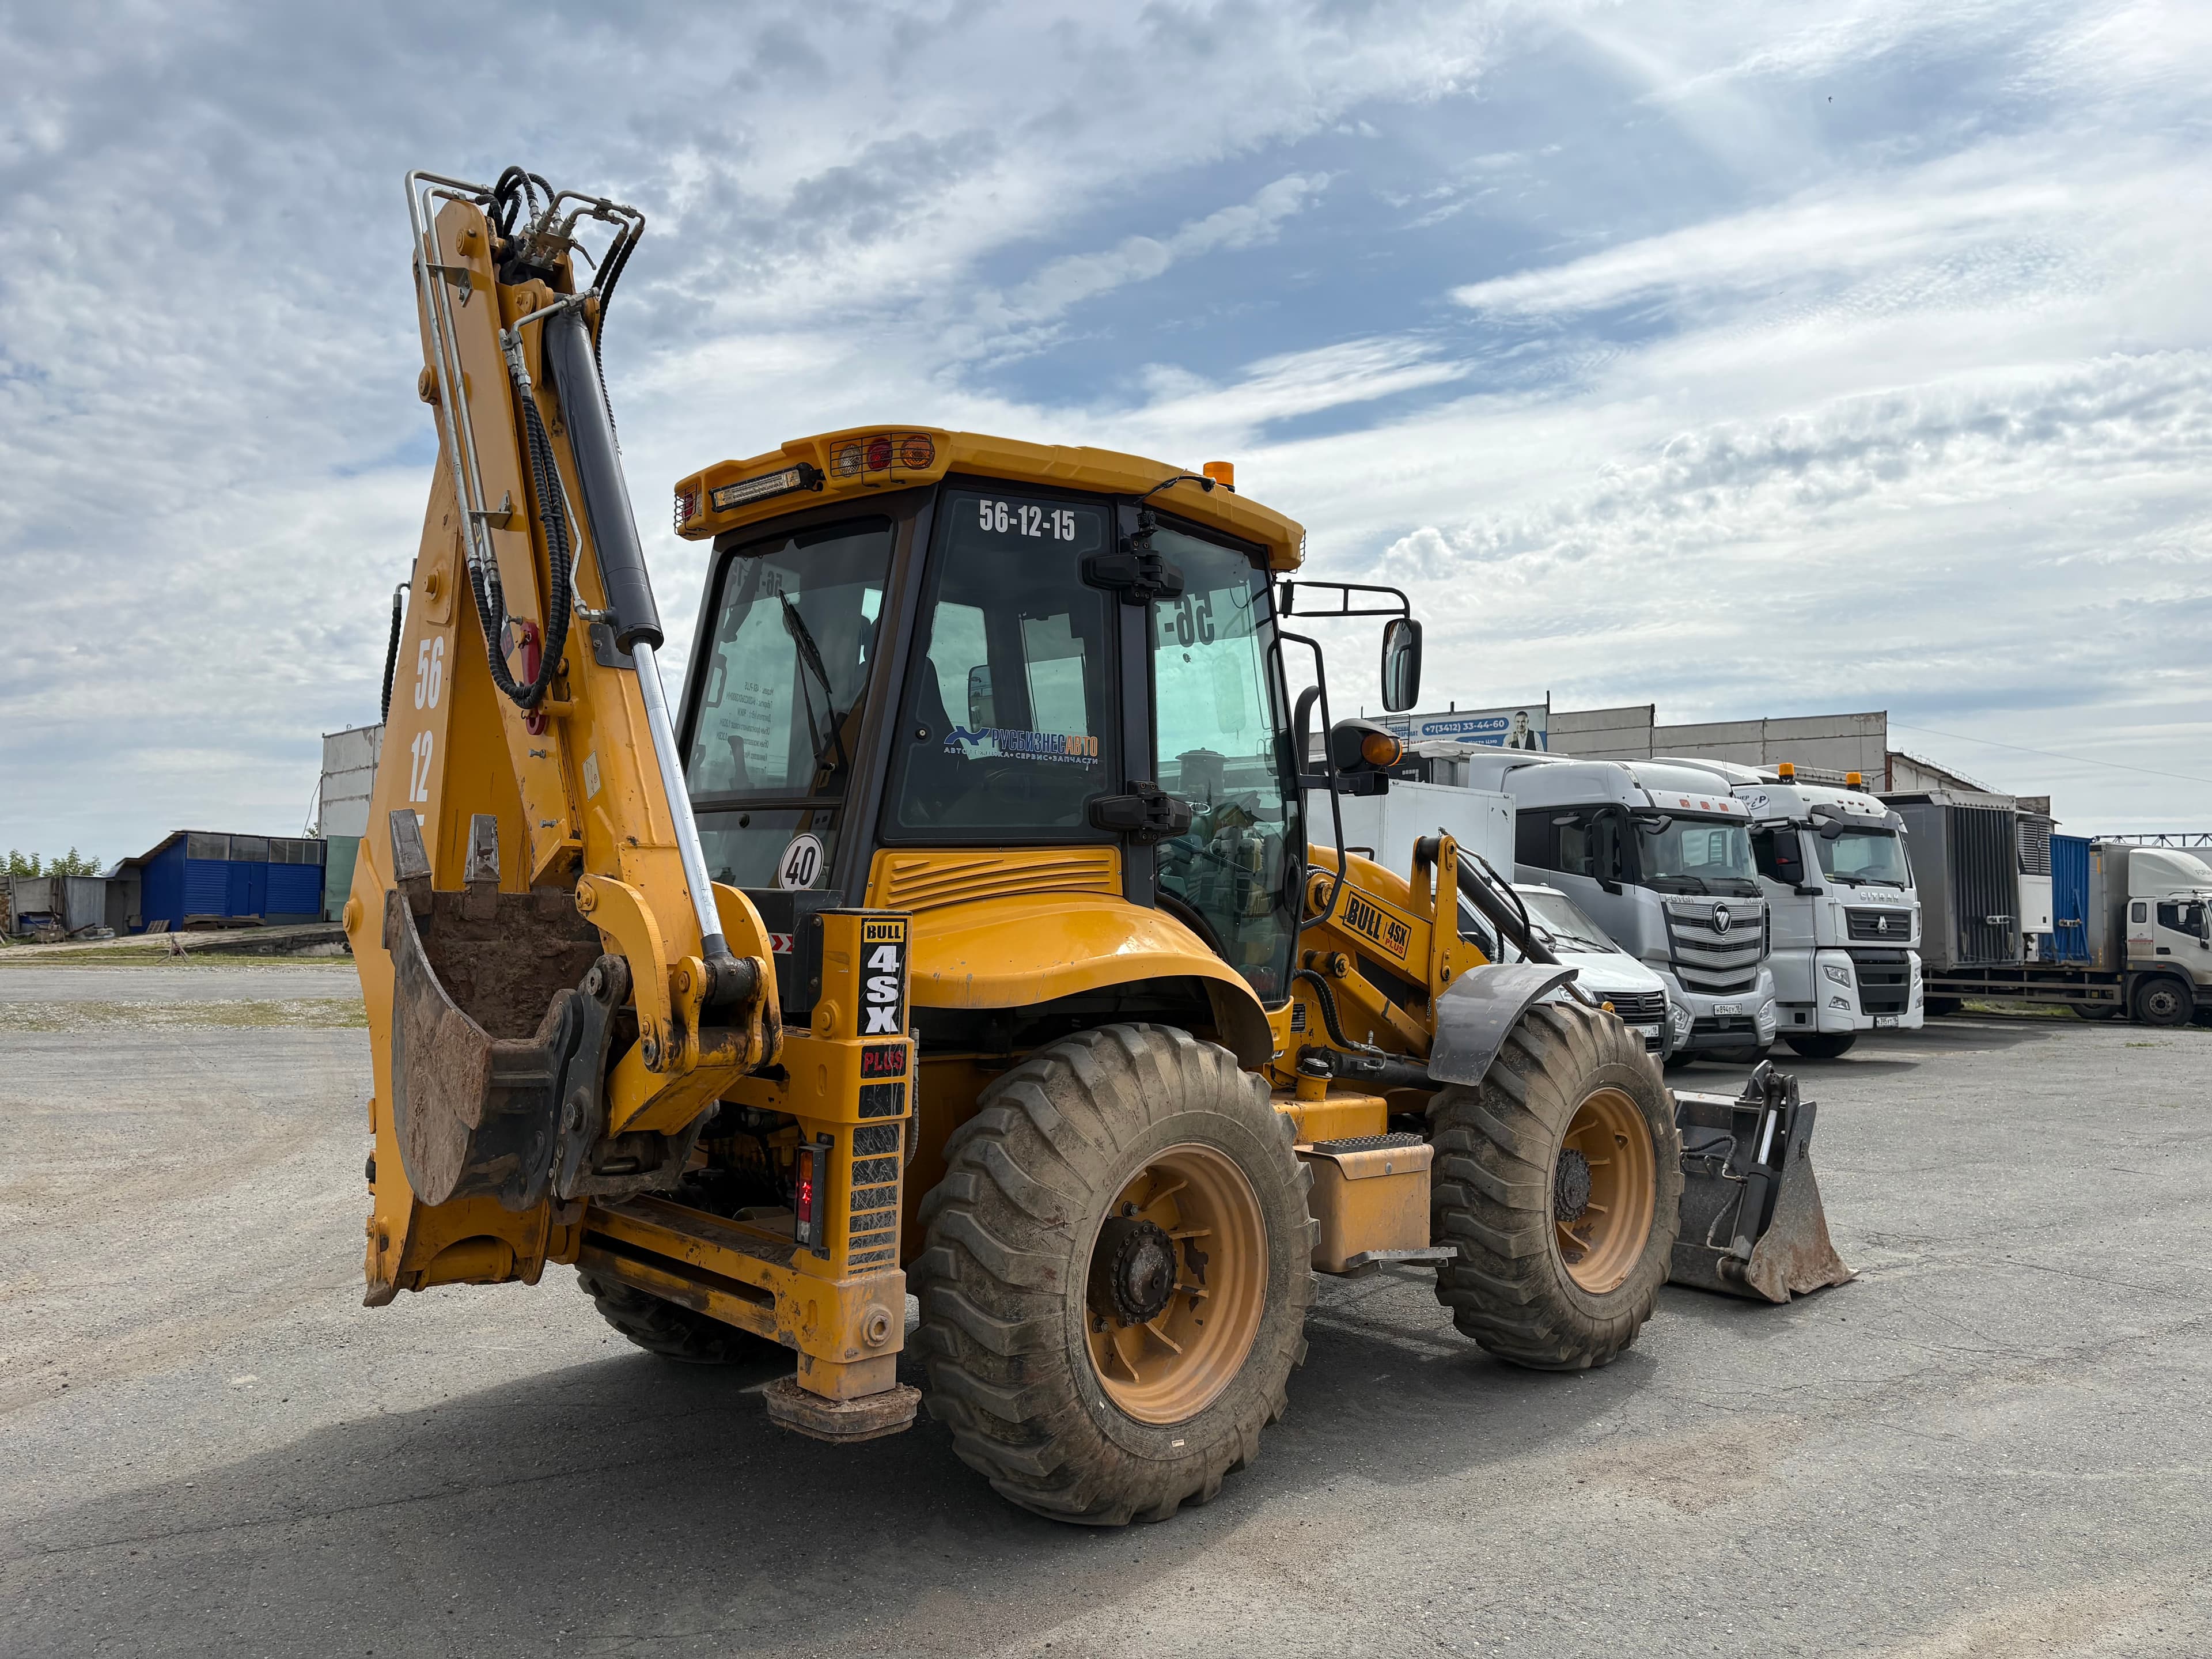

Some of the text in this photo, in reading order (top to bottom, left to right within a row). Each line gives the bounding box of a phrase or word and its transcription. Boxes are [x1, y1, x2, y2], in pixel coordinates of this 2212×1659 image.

[979, 499, 1075, 541] 56-12-15
[414, 636, 444, 710] 56
[1425, 720, 1505, 733] +7(3412) 33-44-60
[991, 728, 1098, 757] РУСБИЗНЕСАВТО
[409, 730, 434, 802] 12
[1015, 752, 1050, 762] СЕРВИС
[1052, 755, 1099, 765] ЗАПЧАСТИ
[785, 846, 816, 885] 40
[1860, 892, 1899, 903] SITRAK
[866, 925, 902, 940] BULL
[1347, 897, 1407, 946] BULL 4SX
[1385, 938, 1404, 955] PLUS
[865, 945, 900, 1034] 4SX
[863, 1049, 904, 1074] PLUS
